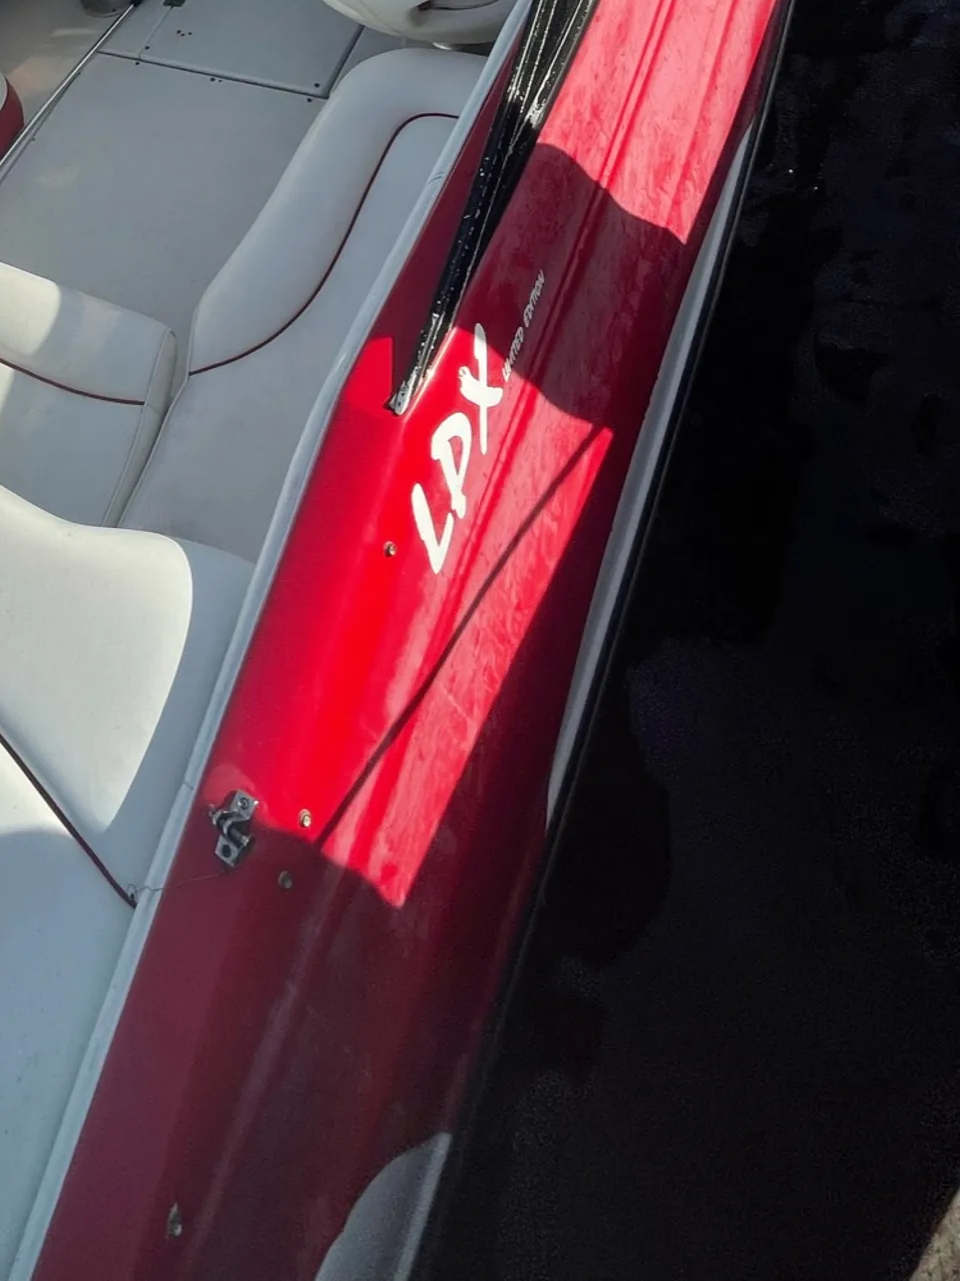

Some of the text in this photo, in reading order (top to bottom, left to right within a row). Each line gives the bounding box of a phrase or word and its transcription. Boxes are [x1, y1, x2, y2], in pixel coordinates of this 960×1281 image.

[502, 269, 545, 382] LIMITED EDITION
[411, 322, 504, 574] LPX
